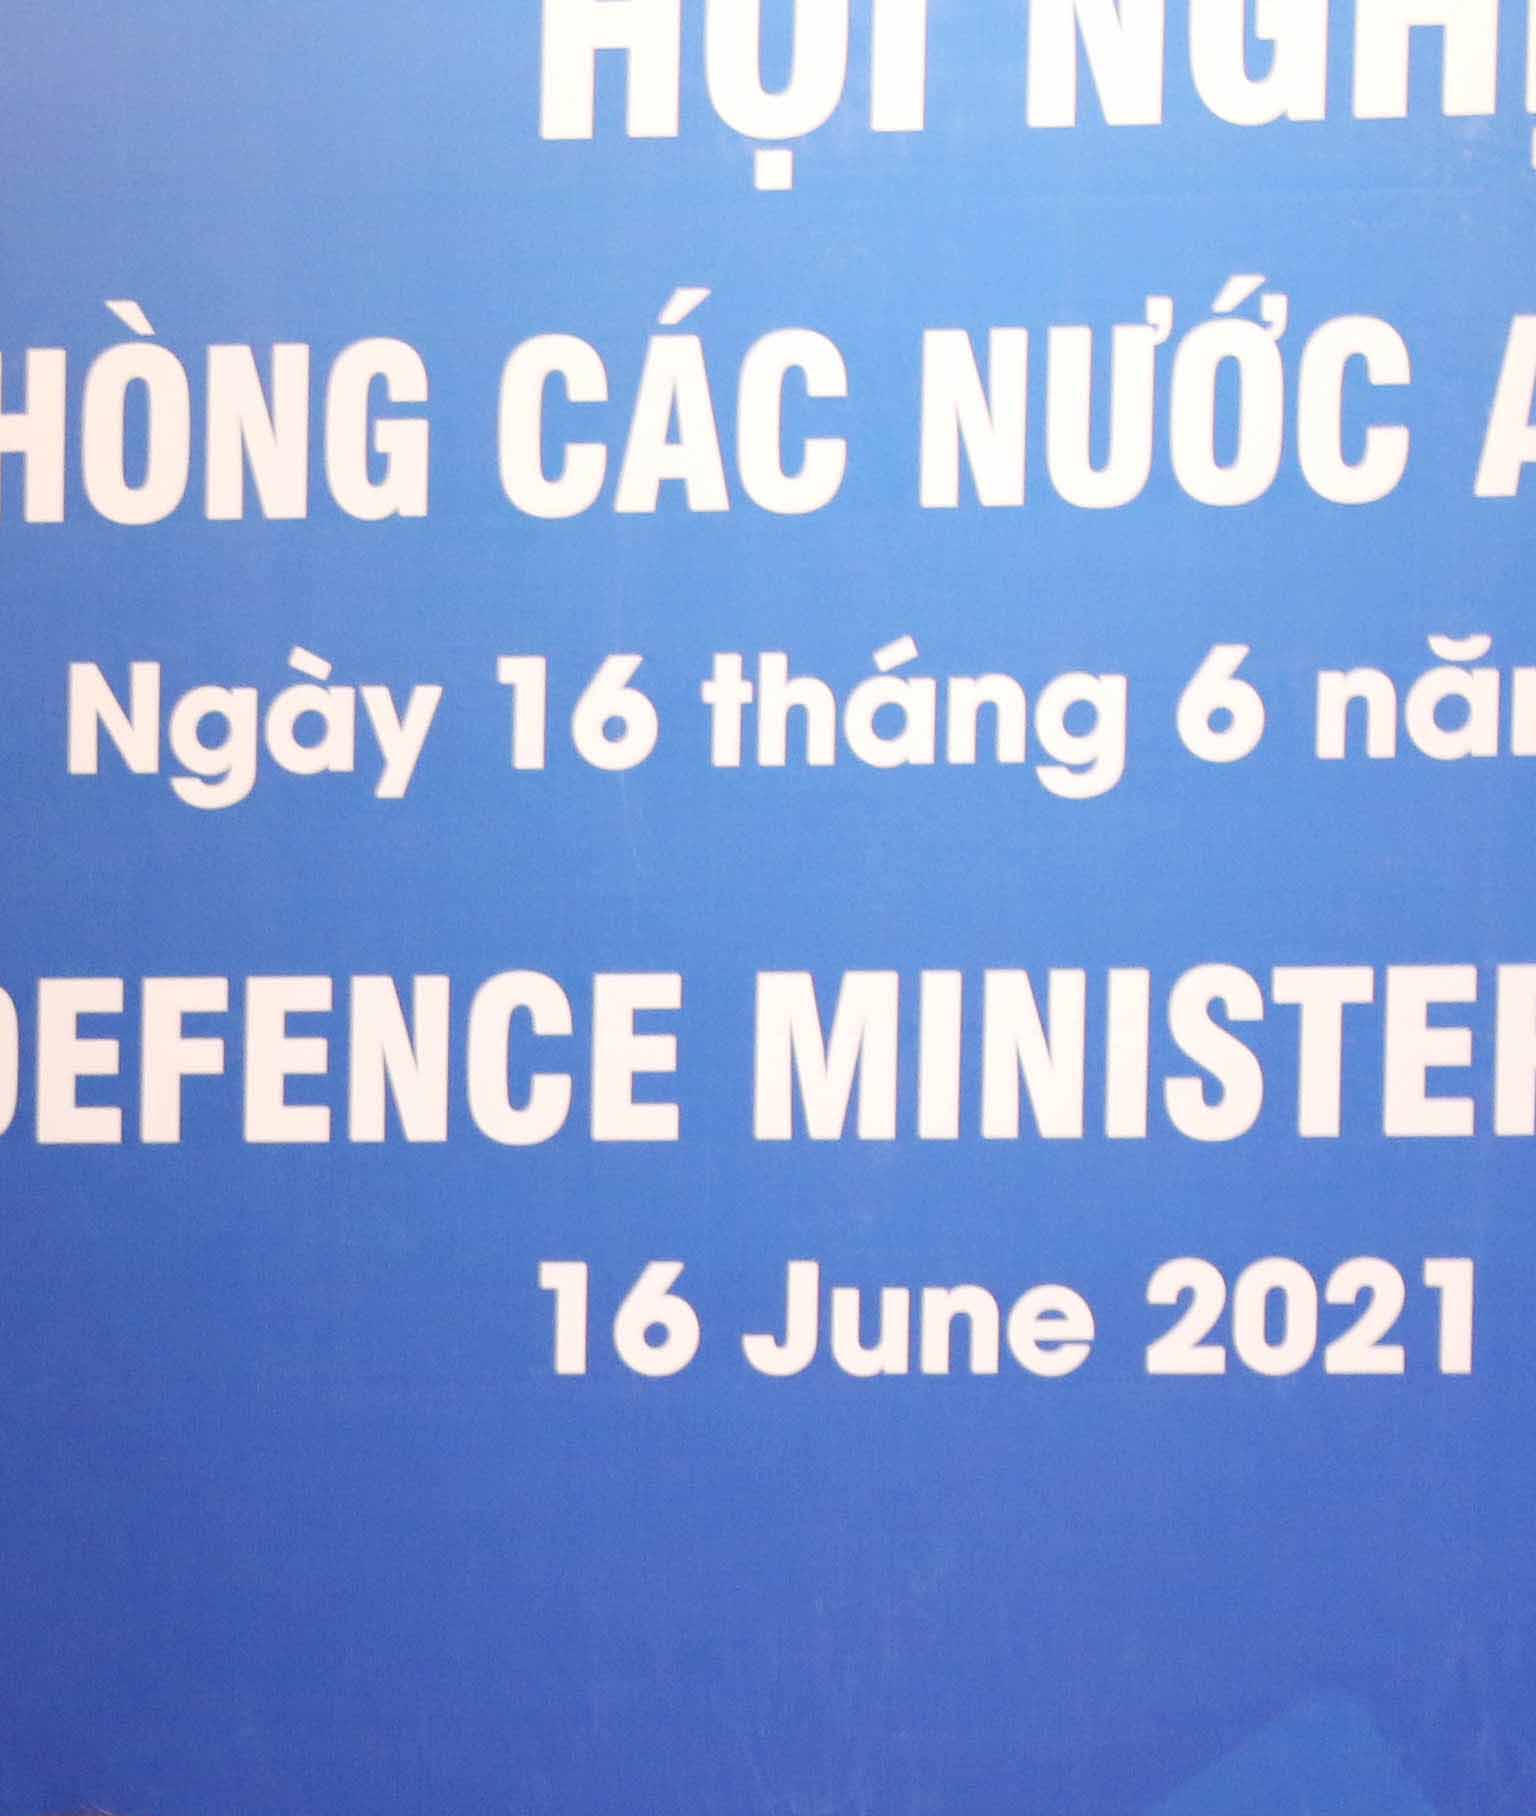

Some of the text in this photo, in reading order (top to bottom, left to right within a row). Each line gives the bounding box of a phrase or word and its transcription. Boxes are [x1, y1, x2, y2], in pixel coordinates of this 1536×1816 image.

[496, 286, 851, 520] CÁC
[917, 273, 1413, 511] NƯỚC
[67, 645, 445, 811] Ngày
[495, 653, 661, 773] 16
[699, 634, 1130, 801] tháng
[1175, 643, 1267, 765] 6
[538, 1255, 1476, 1379] 16 June 2021
